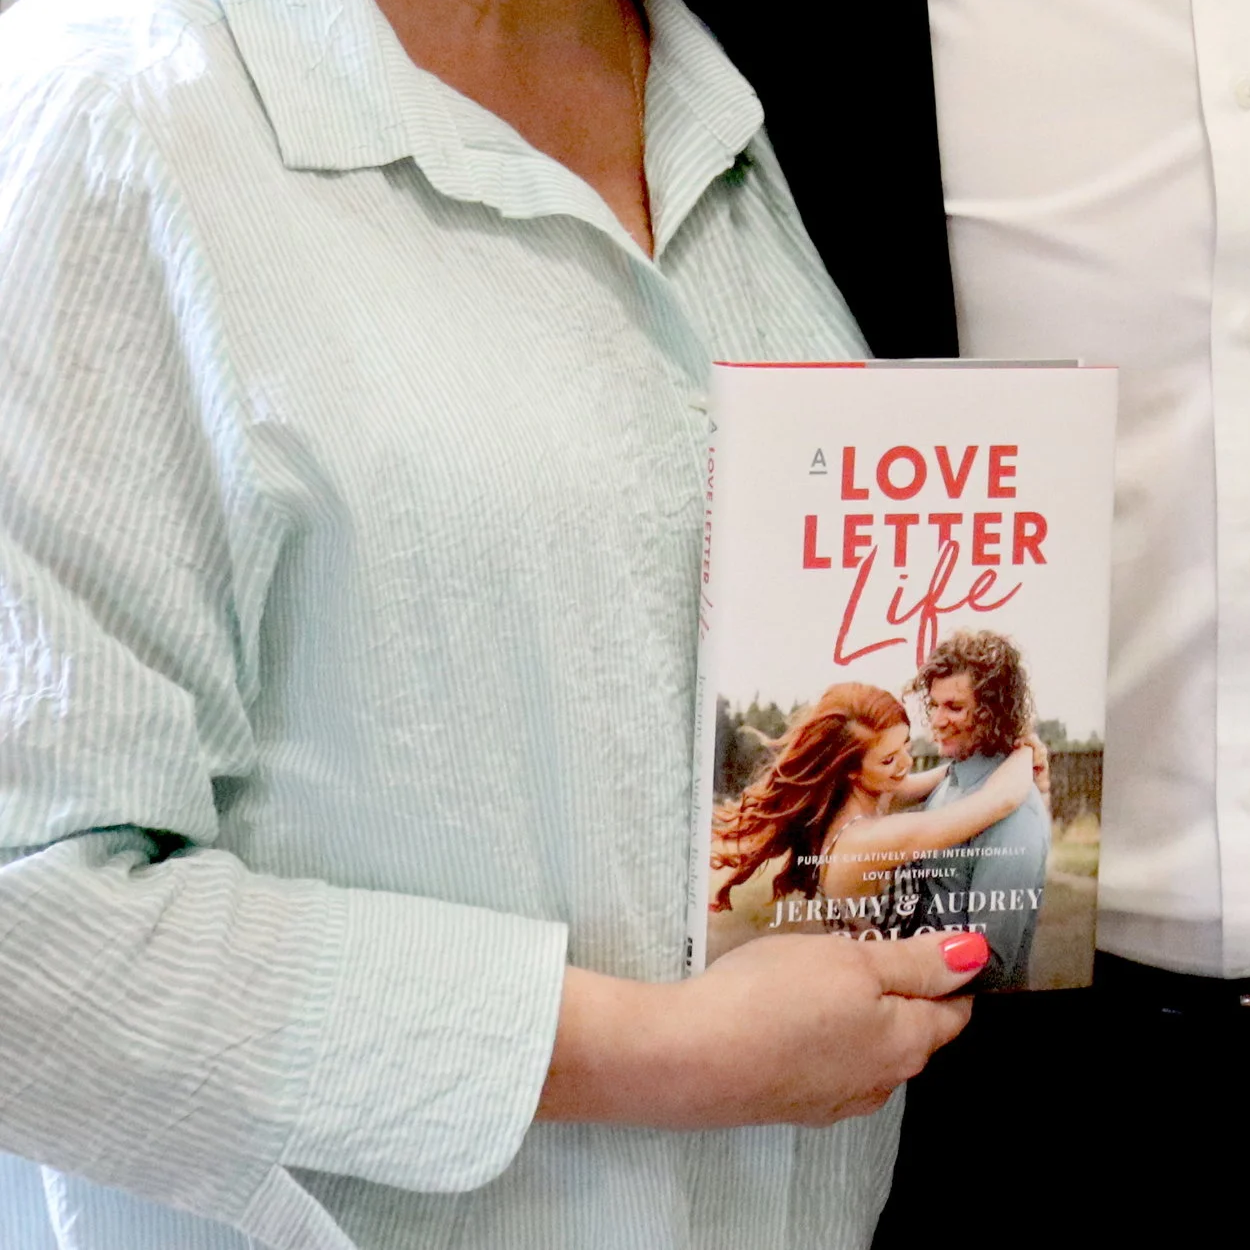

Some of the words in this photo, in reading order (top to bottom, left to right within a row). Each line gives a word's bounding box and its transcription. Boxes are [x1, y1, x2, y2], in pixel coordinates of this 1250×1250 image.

[808, 447, 828, 468] A
[841, 445, 1018, 500] LOVE
[702, 510, 713, 584] LETTER
[803, 512, 1048, 569] LETTER
[834, 540, 1023, 671] Life
[796, 853, 838, 866] PURSUE
[912, 849, 938, 860] DATE
[862, 870, 891, 881] LOVE
[769, 896, 889, 928] JEREMY
[896, 894, 919, 916] &
[928, 888, 1044, 915] AUDREY
